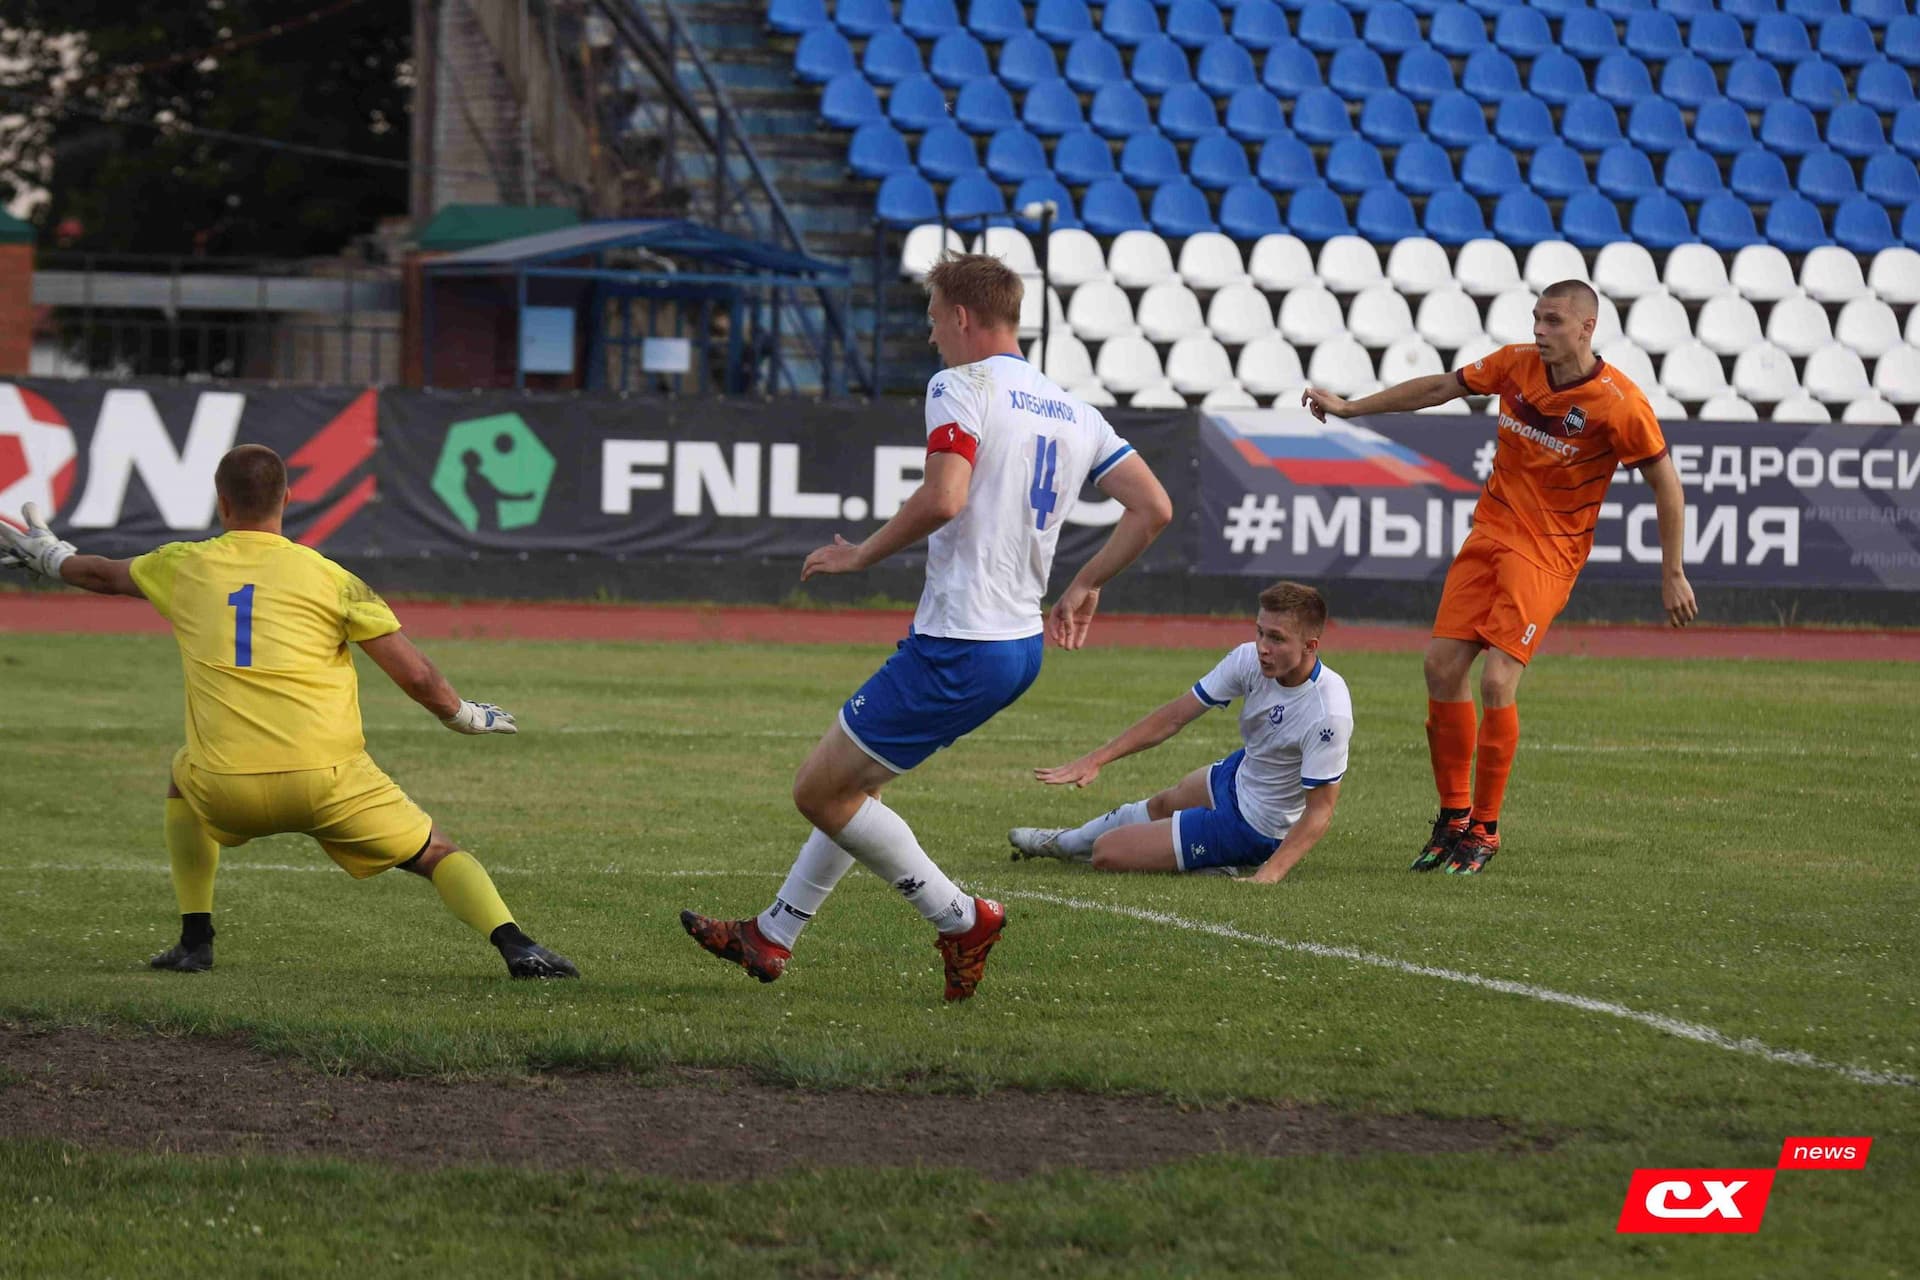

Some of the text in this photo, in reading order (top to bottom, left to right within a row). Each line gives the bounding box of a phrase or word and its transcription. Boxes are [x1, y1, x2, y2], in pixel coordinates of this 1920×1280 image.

[1029, 434, 1058, 531] 4
[227, 584, 254, 667] 1
[1521, 622, 1537, 646] 9
